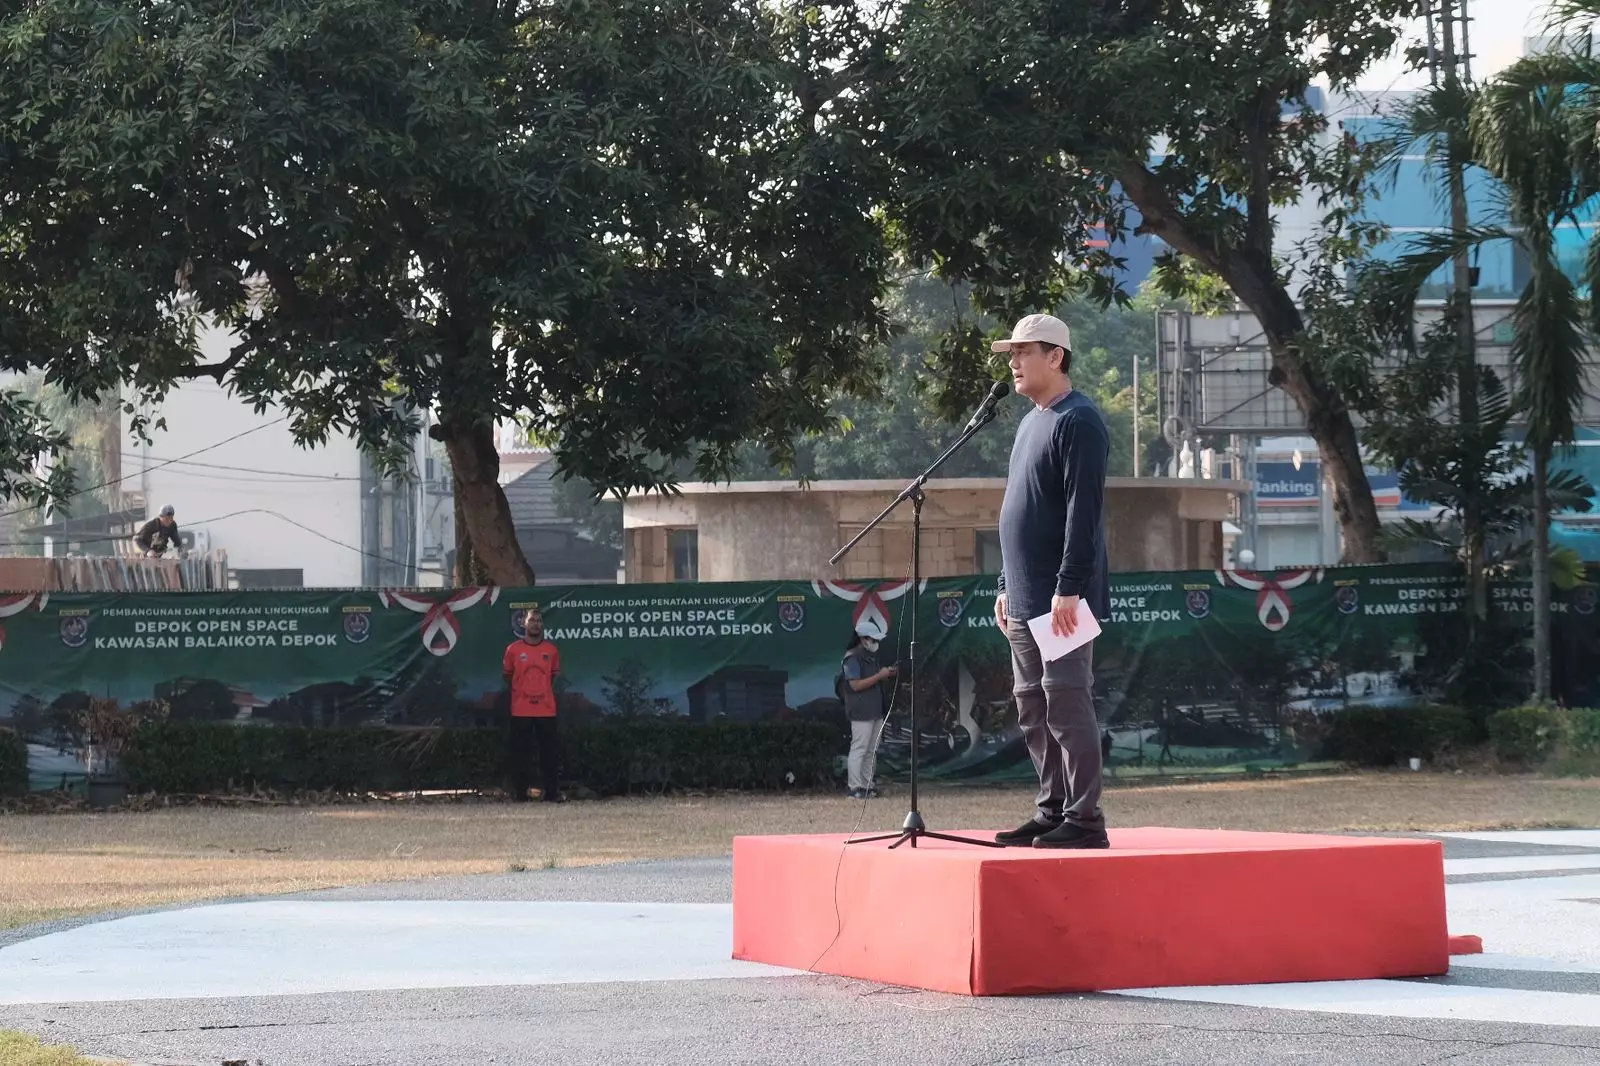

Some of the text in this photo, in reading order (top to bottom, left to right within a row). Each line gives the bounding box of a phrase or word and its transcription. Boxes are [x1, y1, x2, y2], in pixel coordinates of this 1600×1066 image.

[1116, 584, 1172, 592] LINGKUNGAN
[1398, 588, 1446, 600] DEPOK
[550, 600, 625, 608] PEMBANGUNAN
[651, 598, 701, 606] PENATAAN
[704, 596, 765, 604] LINGKUNGAN
[1110, 597, 1146, 608] PACE
[1523, 602, 1568, 613] DOK
[103, 606, 329, 616] PEMBANGUNAN DAN PENATAAN LINGKUNGAN
[582, 610, 736, 624] DEPOK OPEN SPACE
[1132, 610, 1182, 622] DEPOK
[135, 620, 298, 632] DEPOK OPEN SPACE
[544, 623, 773, 640] KAWASAN BALAIKOTA DEPOK
[95, 634, 338, 648] KAWASAN BALAIKOTA DEPOK
